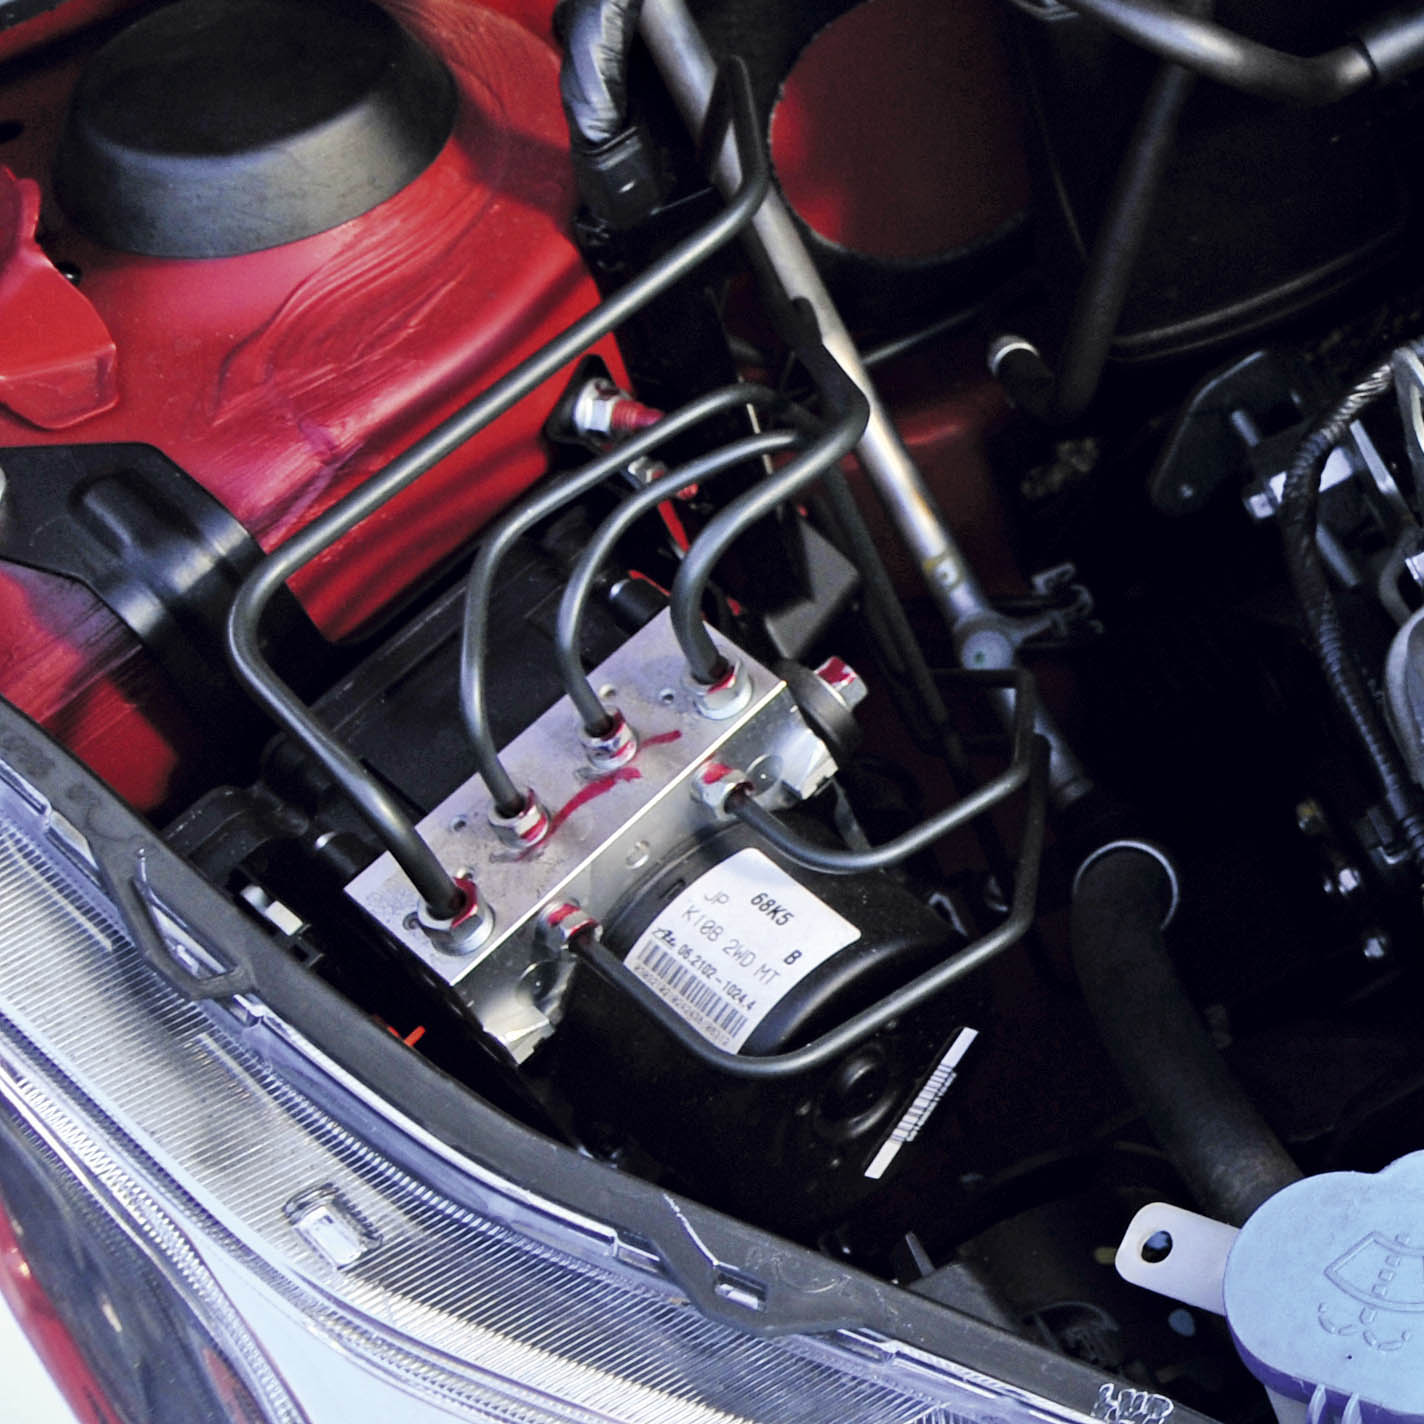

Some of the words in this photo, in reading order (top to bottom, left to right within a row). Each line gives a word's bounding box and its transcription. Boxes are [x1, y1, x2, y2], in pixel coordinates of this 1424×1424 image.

[750, 892, 794, 926] 68K5
[722, 938, 756, 968] 2WD
[753, 962, 781, 985] MT
